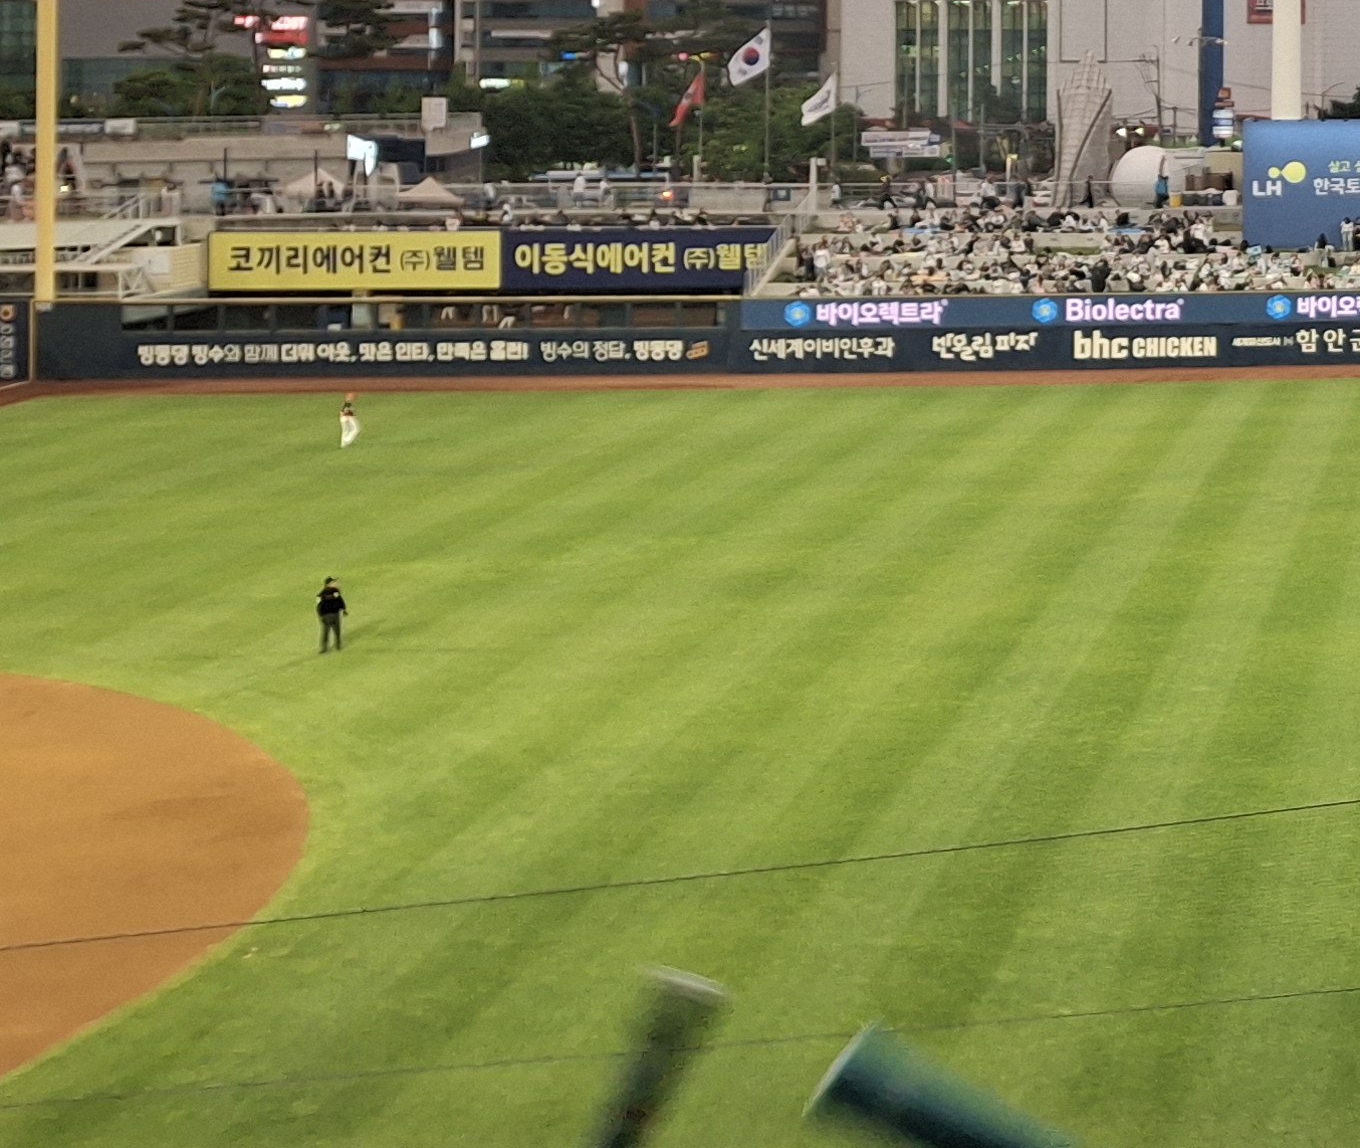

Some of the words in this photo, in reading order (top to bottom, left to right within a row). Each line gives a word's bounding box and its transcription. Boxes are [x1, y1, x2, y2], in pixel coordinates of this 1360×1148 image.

[1328, 160, 1350, 173] 살고
[1252, 180, 1282, 196] LH
[228, 245, 392, 275] 코끼리에어컨
[514, 242, 676, 275] 이동식에어컨
[815, 300, 944, 326] 바이오렉트라
[1065, 298, 1180, 322] Biolectra
[281, 343, 315, 362] 더위
[540, 340, 590, 363] 빙수의
[749, 336, 895, 360] 신세계이비인후과
[1073, 330, 1128, 360] bhc
[1132, 336, 1217, 359] CHICKEN
